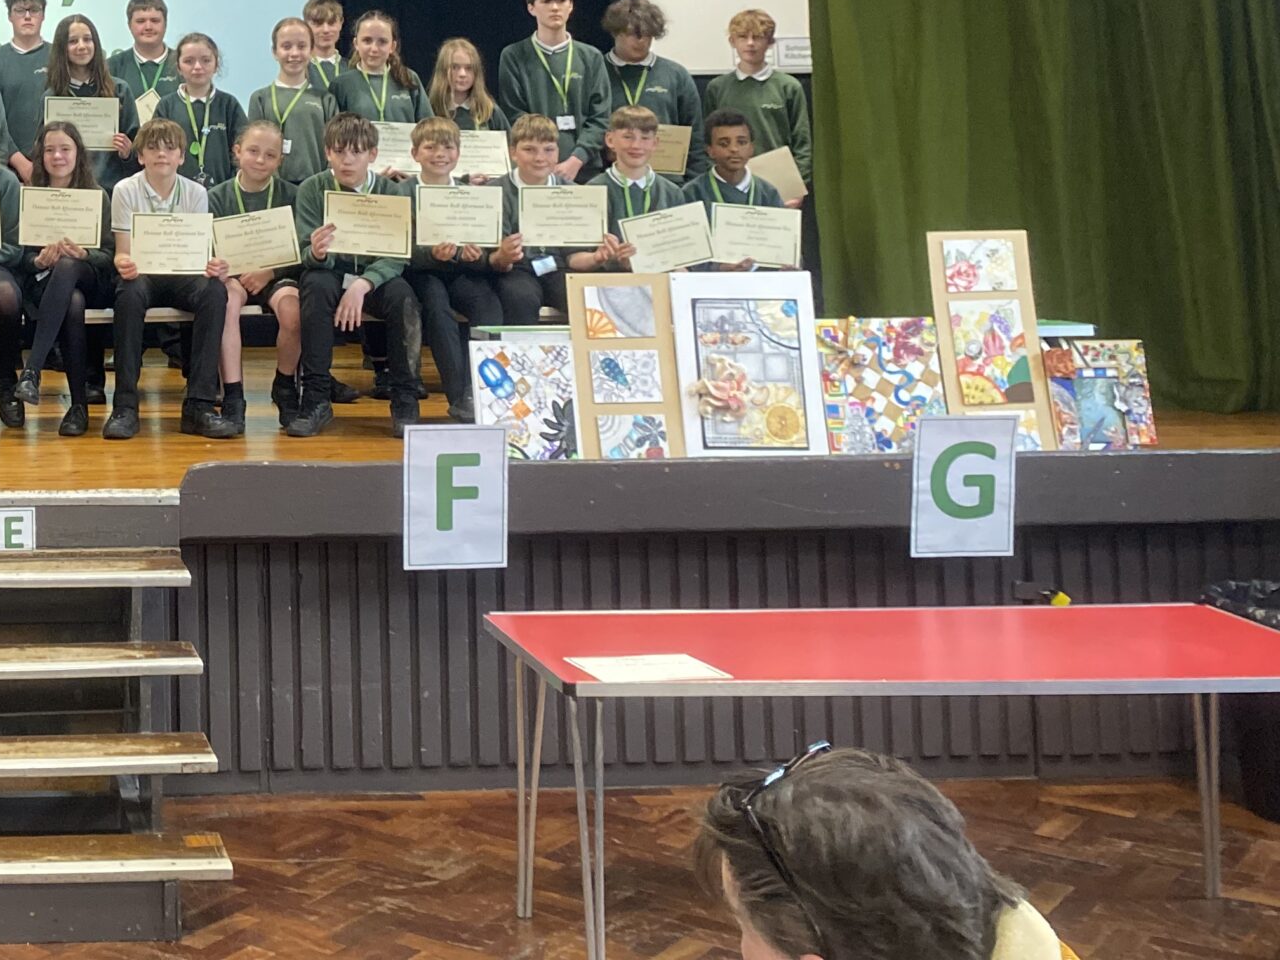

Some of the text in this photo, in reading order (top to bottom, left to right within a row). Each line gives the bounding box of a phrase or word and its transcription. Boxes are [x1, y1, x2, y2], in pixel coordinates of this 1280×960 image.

[436, 453, 481, 531] F
[930, 441, 996, 519] G
[4, 516, 24, 548] E
